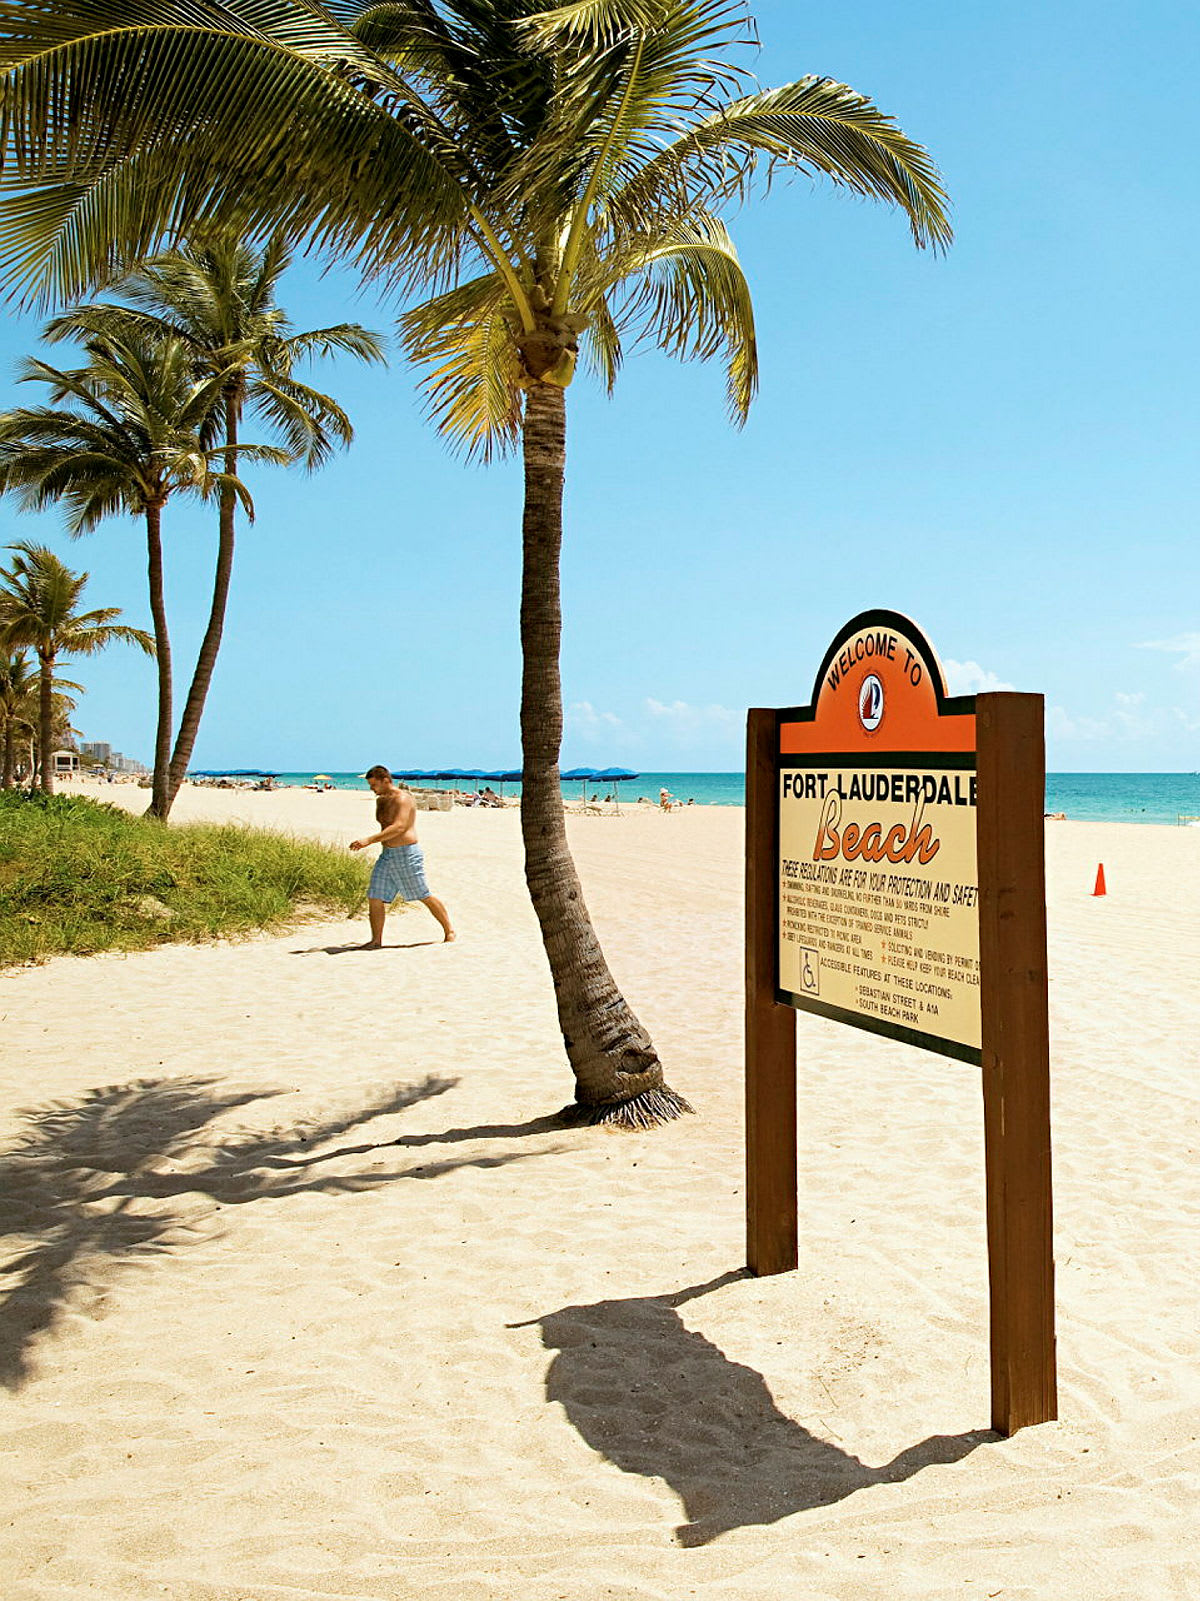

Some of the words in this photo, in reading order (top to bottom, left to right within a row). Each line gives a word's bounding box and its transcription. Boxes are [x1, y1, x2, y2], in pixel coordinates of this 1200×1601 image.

[827, 632, 898, 692] WELCOME
[904, 648, 922, 687] TO
[783, 773, 829, 800] FORT
[812, 787, 941, 865] Beach
[782, 860, 799, 878] THESE
[799, 862, 837, 884] REGULATIONS
[839, 868, 853, 887] ARE
[853, 870, 867, 889] FOR
[869, 872, 887, 892] YOUR
[888, 875, 933, 901] PROTECTION
[933, 882, 951, 903] AND
[952, 884, 979, 907] SAFET
[820, 957, 851, 974] ACCESSIBLE
[853, 964, 882, 982] FEATURES
[883, 973, 891, 984] AT
[893, 974, 914, 990] THESE
[947, 967, 964, 982] BEACH
[965, 972, 980, 986] CLEA
[858, 985, 891, 1002] SEBASTIAN
[892, 993, 917, 1009] STREET
[919, 1000, 924, 1011] &
[926, 1003, 940, 1016] A1A
[858, 997, 879, 1011] SOUTH
[880, 1003, 901, 1019] BEACH
[901, 1009, 920, 1024] PARK
